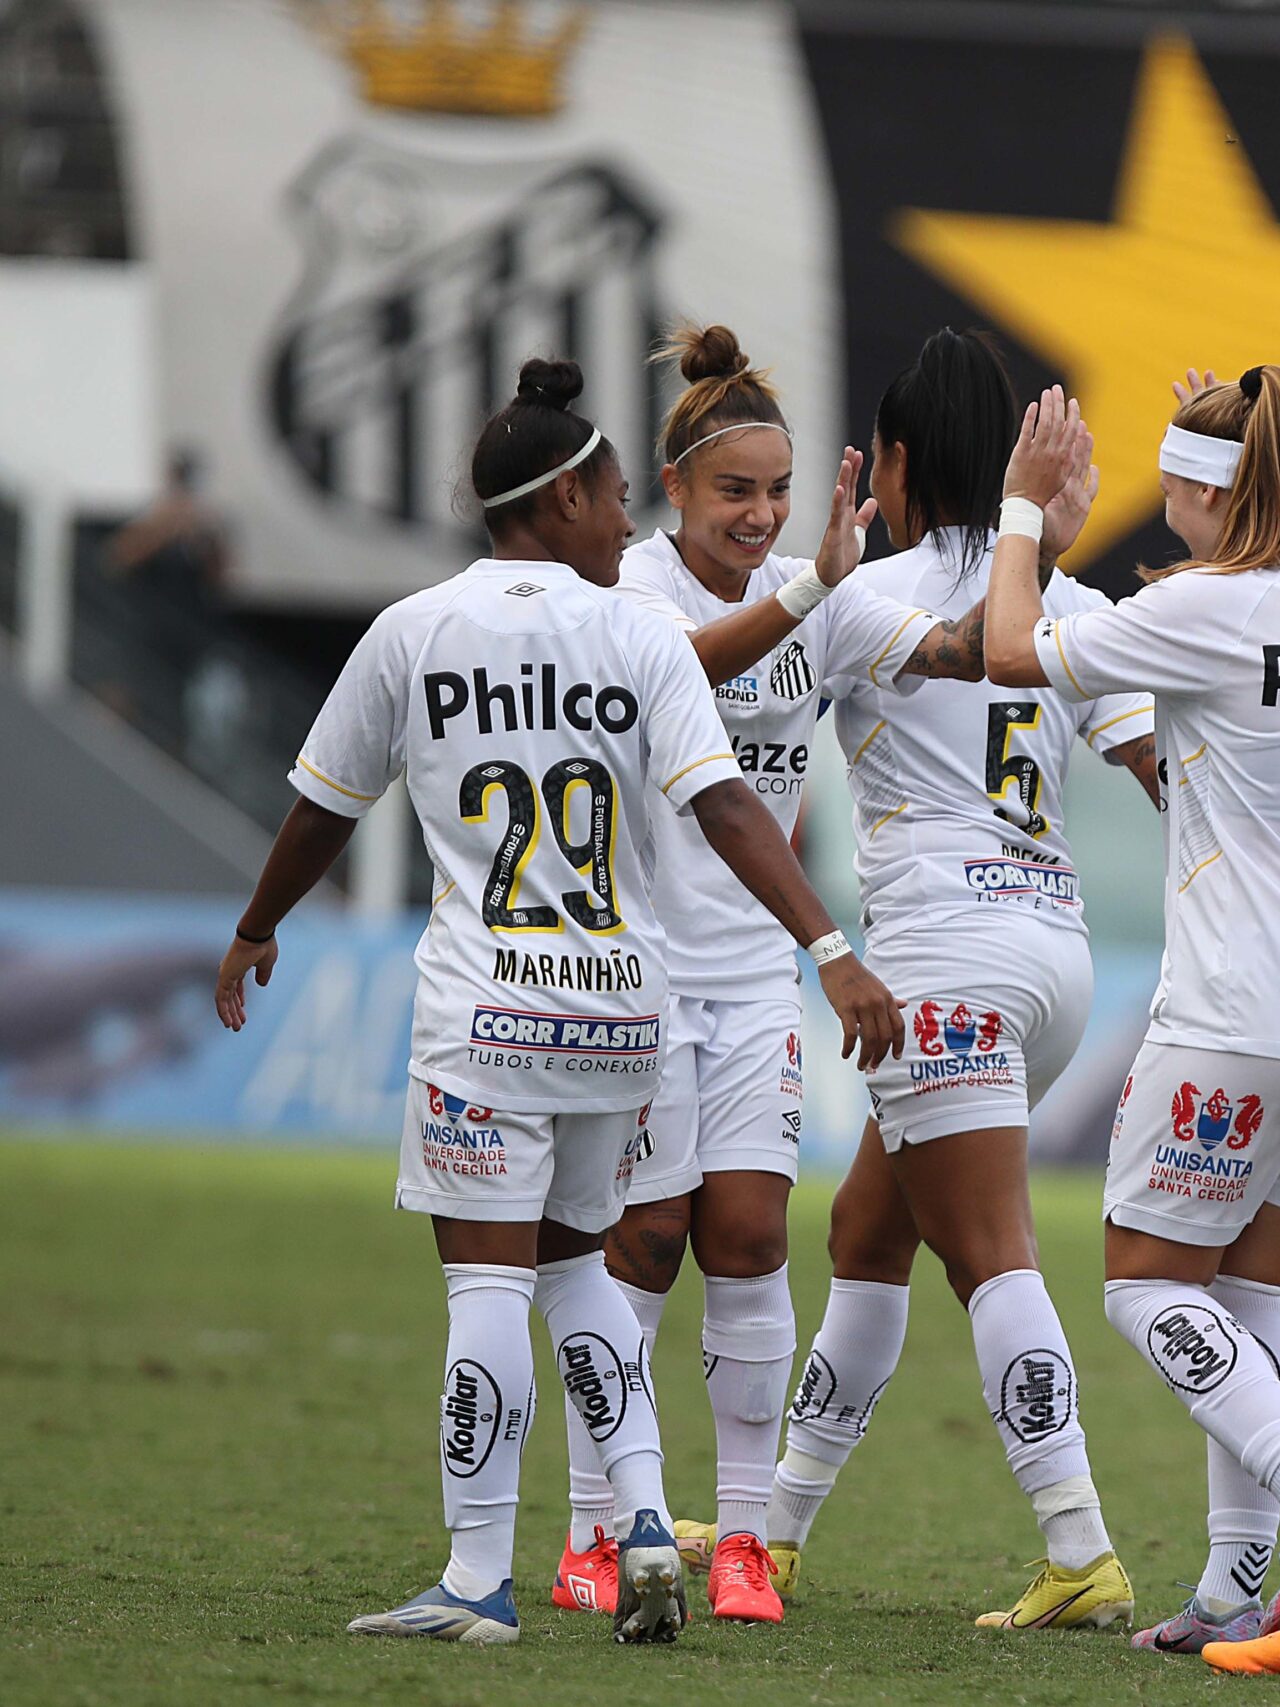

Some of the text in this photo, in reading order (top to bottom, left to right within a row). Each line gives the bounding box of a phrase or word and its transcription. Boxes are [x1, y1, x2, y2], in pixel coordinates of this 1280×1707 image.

[423, 663, 639, 740] Philco
[716, 688, 758, 702] BOND
[985, 701, 1050, 840] 5
[459, 757, 629, 936] 29
[597, 865, 608, 894] 2023
[493, 948, 643, 992] MARANHÃO
[474, 1012, 658, 1048] CORR PLASTIK
[467, 1049, 658, 1074] TUBOS E CONEXÕES
[911, 1052, 1009, 1081] UNISANTA
[421, 1121, 505, 1149] UNISANTA
[423, 1141, 507, 1163] UNIVERSIDADE
[424, 1155, 508, 1176] SANTA CECÍLIA
[1156, 1145, 1254, 1178] UNISANTA
[1148, 1178, 1245, 1203] SANTA CECÍLIA
[1151, 1164, 1250, 1190] UNIVERSIDADE
[1154, 1312, 1228, 1386] Kodilar
[562, 1343, 615, 1430] Kodilar
[446, 1367, 479, 1466] Kodilar
[504, 1408, 522, 1441] SFC
